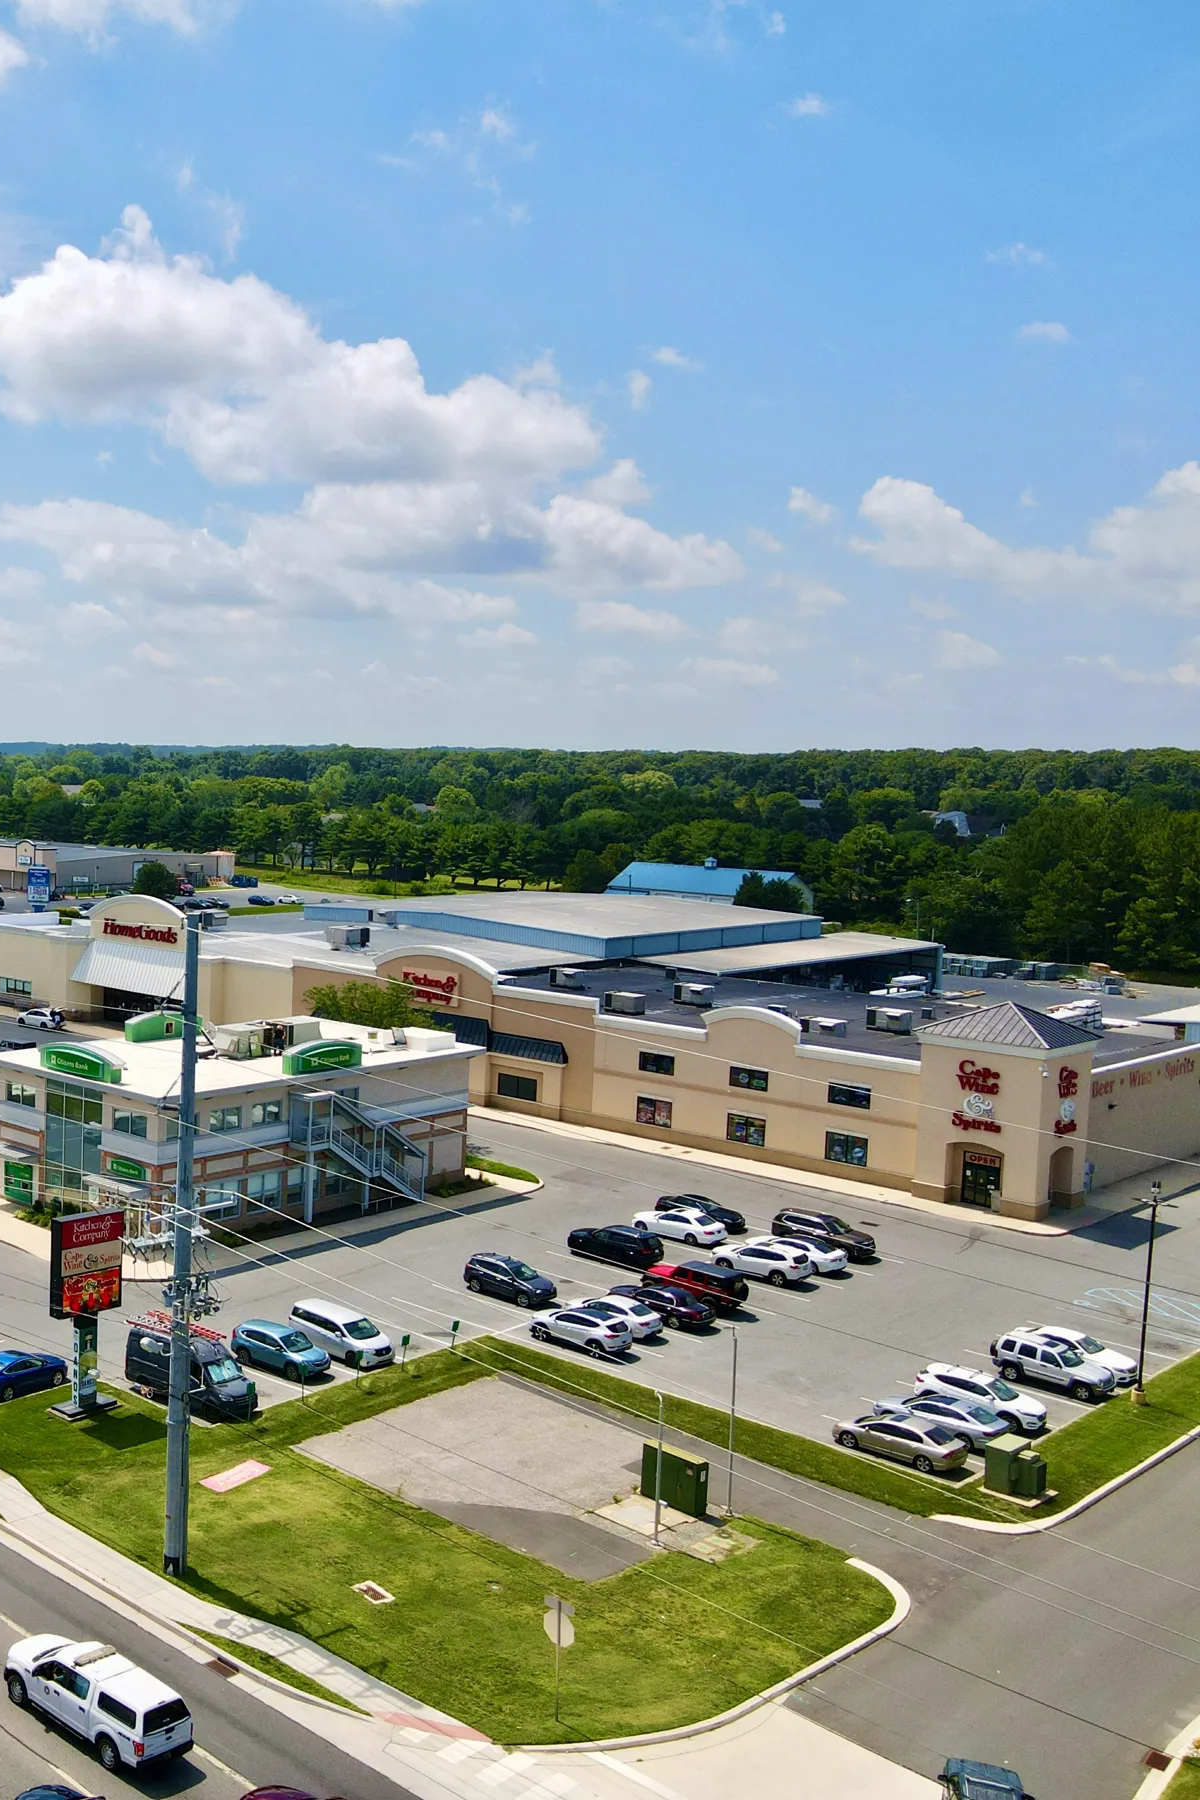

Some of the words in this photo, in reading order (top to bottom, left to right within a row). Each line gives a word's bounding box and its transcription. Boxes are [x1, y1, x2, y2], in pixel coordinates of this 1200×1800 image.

[103, 918, 178, 944] HomeGoods
[56, 1057, 75, 1068] Citizens
[75, 1062, 89, 1071] Bank
[959, 1060, 1000, 1083] Cape
[1165, 1057, 1195, 1081] Spirits
[956, 1074, 999, 1095] Wine
[952, 1110, 1001, 1134] Spirits
[969, 1154, 996, 1166] OPEN
[72, 1229, 111, 1243] Company
[73, 1221, 102, 1233] Kitchen
[63, 1259, 83, 1272] Wine
[100, 1253, 121, 1264] Spirits
[64, 1250, 84, 1262] Cape
